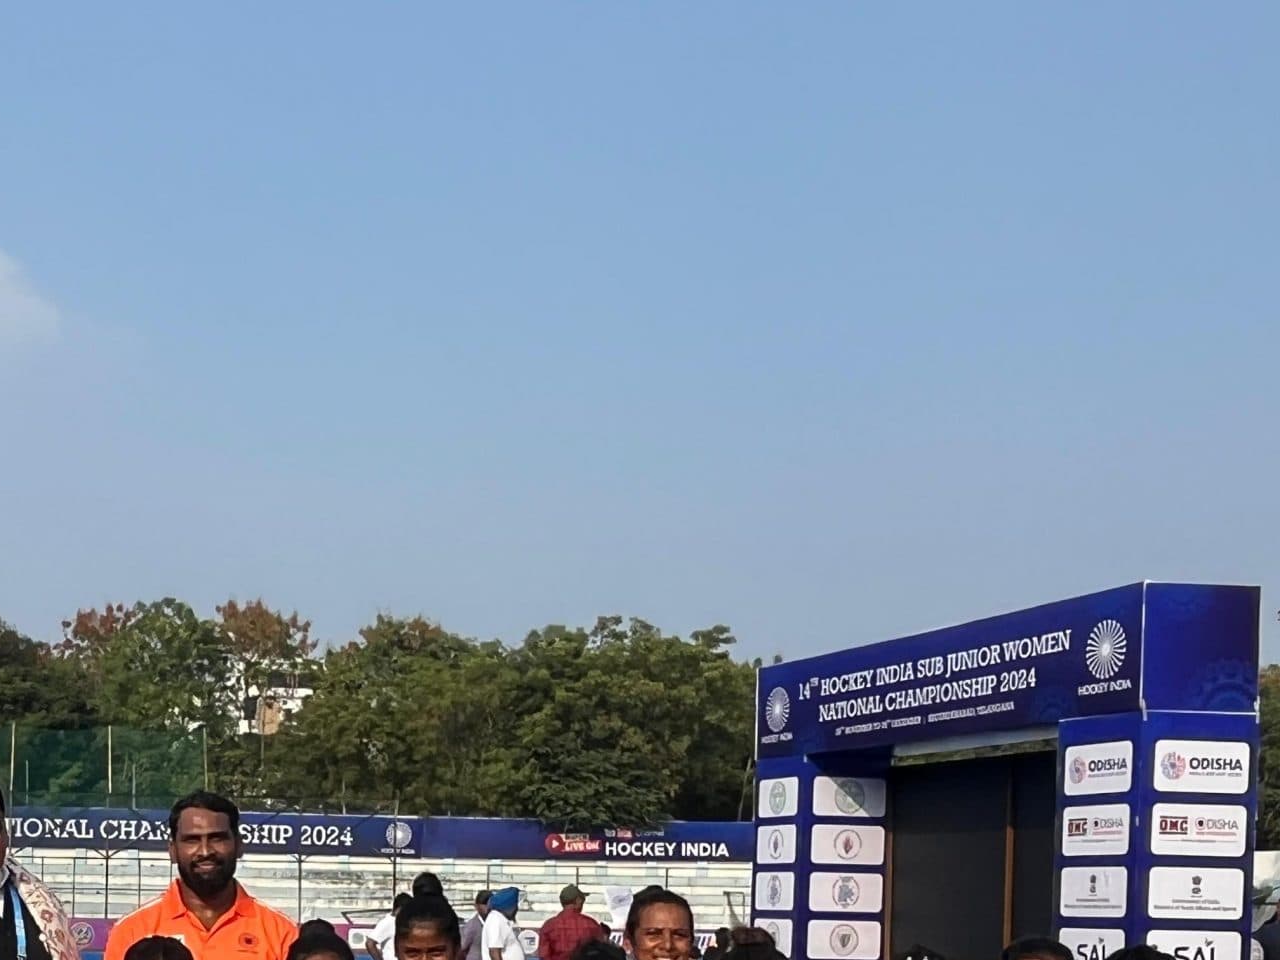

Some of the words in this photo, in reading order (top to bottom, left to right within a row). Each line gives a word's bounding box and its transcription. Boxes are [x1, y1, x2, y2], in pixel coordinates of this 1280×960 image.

[821, 670, 874, 696] HOCKEY
[876, 662, 914, 686] INDIA
[917, 656, 944, 678] SUB
[945, 645, 1000, 678] JUNIOR
[1002, 630, 1072, 662] WOMEN
[819, 695, 883, 722] NATIONAL
[885, 674, 997, 711] CHAMPIONSHIP
[1000, 667, 1037, 692] 2024
[1078, 681, 1109, 697] HOCKEY
[1088, 757, 1128, 772] ODISHA
[1189, 757, 1243, 771] ODISHA
[300, 825, 354, 846] 2024
[605, 842, 676, 857] HOCKEY
[681, 842, 729, 857] INDIA
